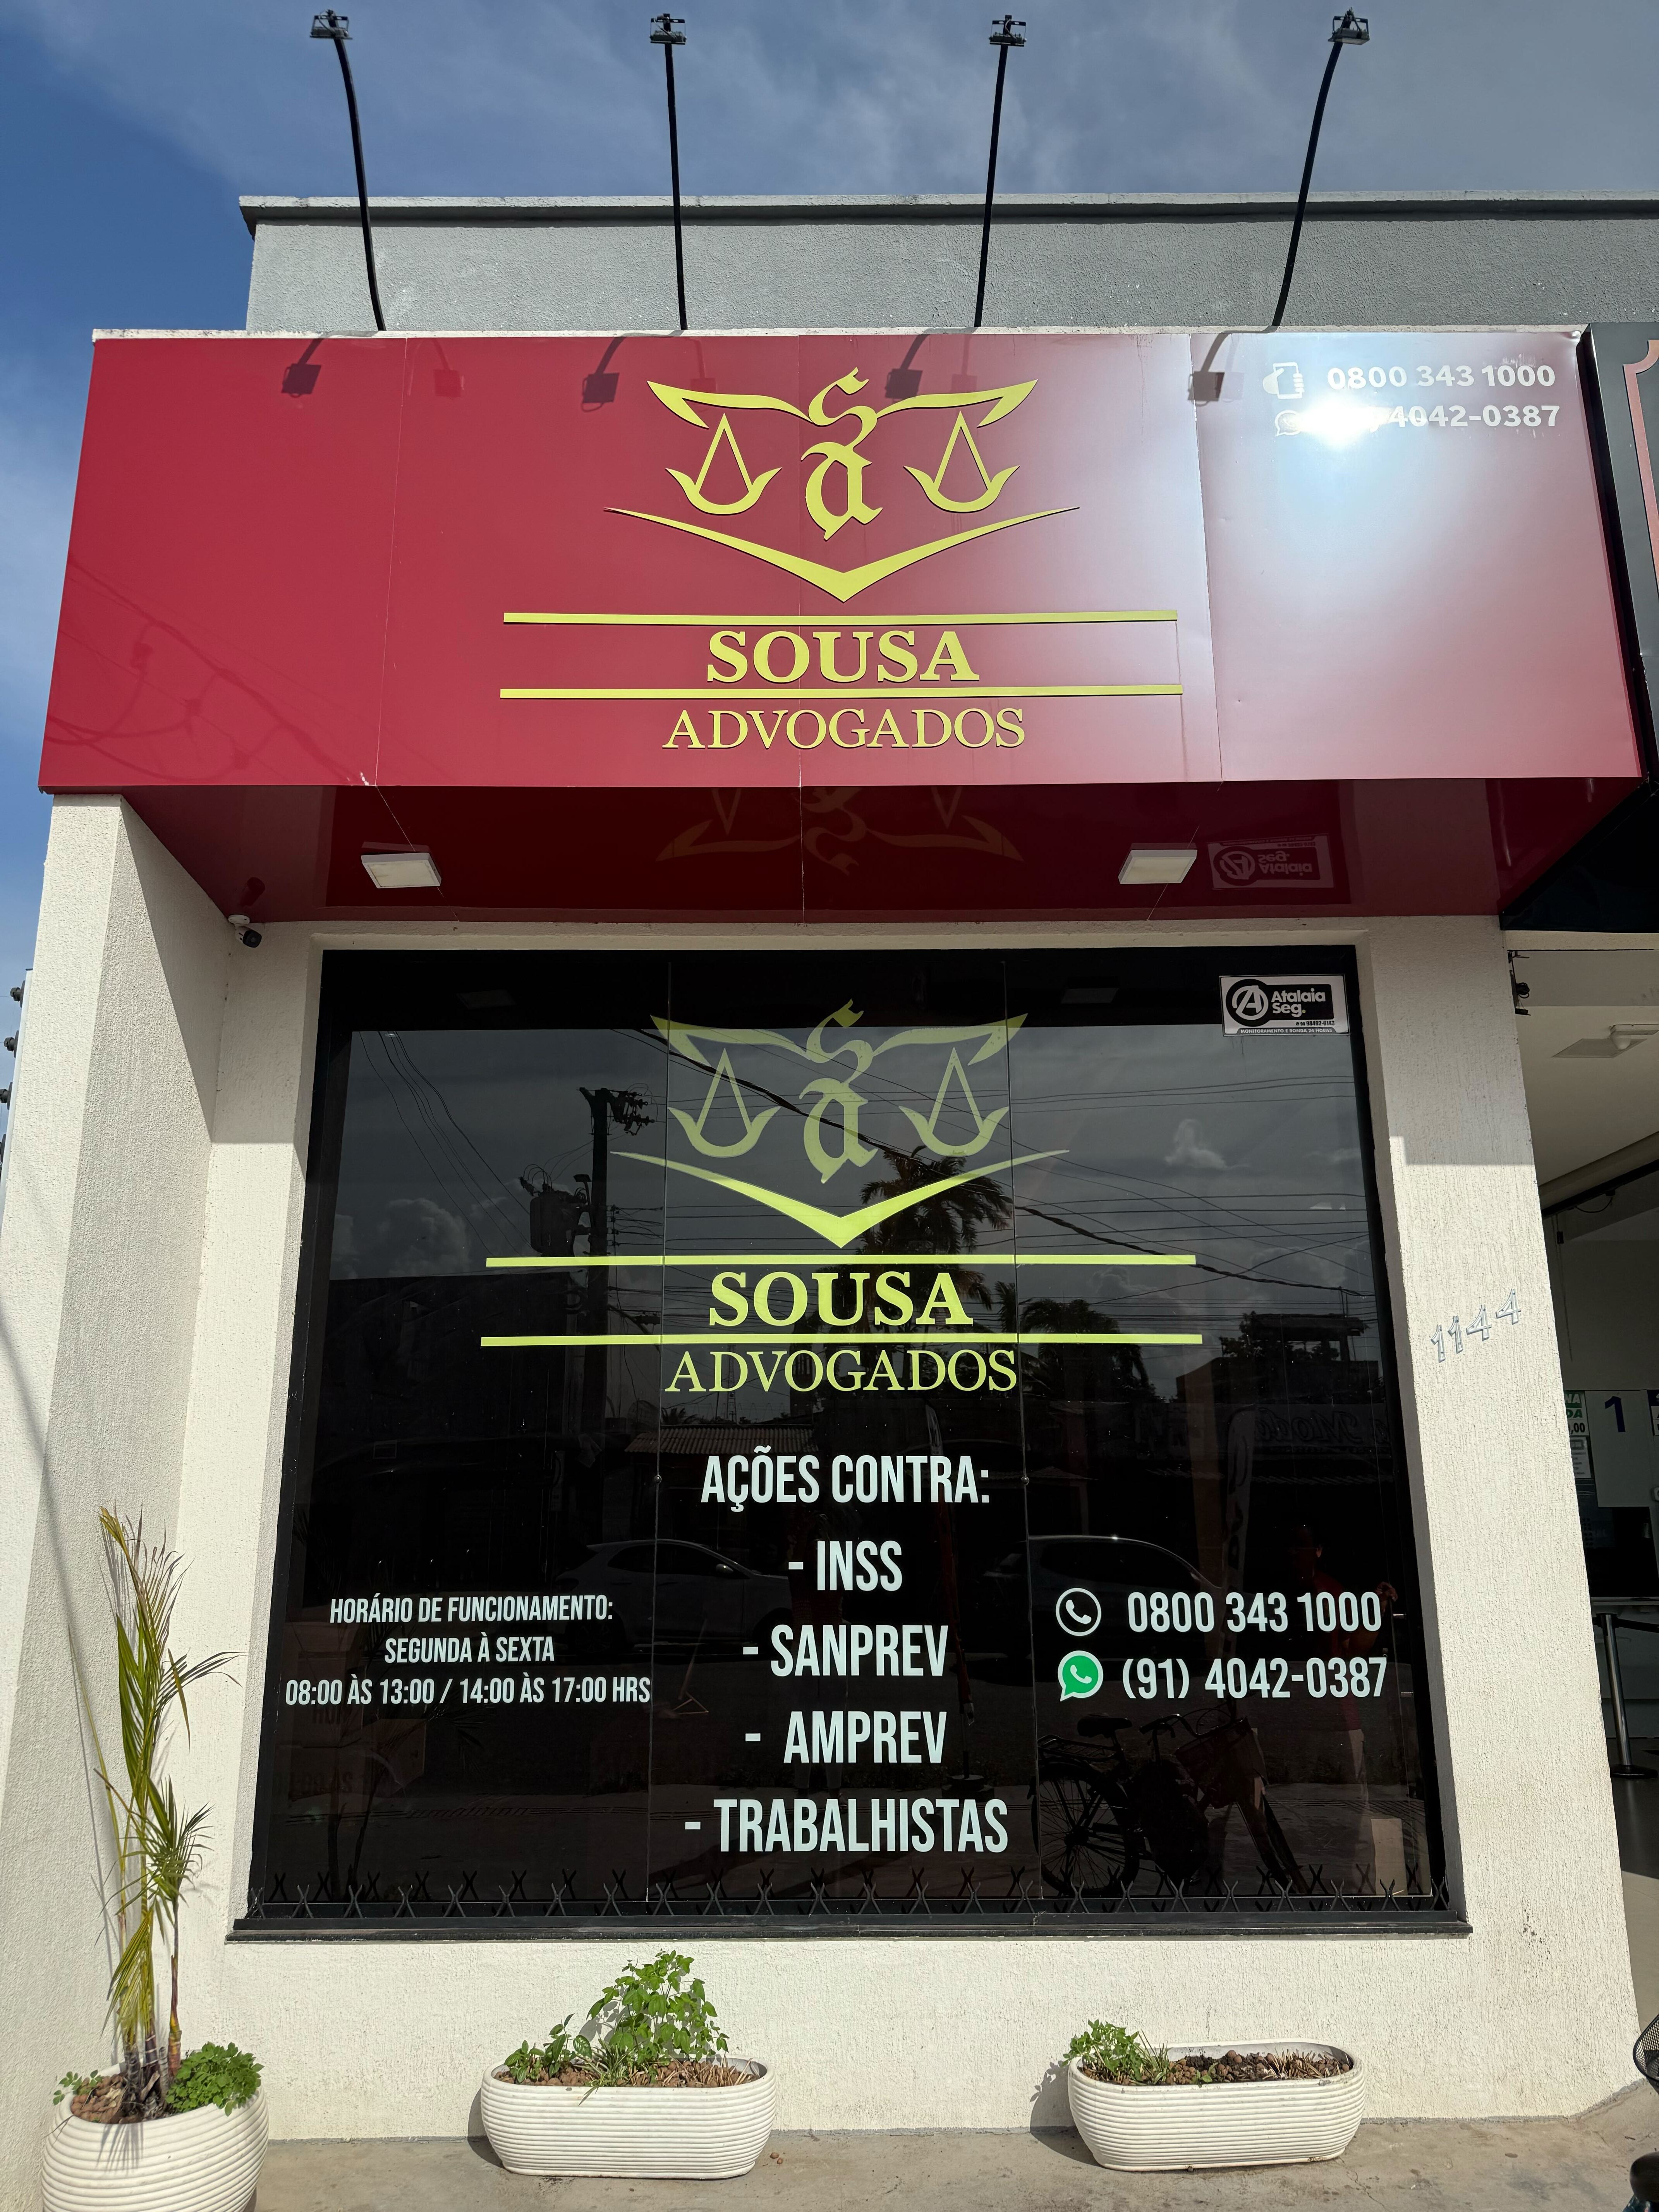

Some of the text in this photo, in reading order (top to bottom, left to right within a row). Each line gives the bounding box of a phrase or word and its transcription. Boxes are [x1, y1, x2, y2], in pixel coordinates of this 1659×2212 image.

[1328, 365, 1555, 390] 0800 343 1000
[1389, 405, 1560, 427] 4042-0387
[708, 631, 979, 682] SOUSA
[663, 708, 1024, 749] ADVOGADOS
[1271, 988, 1326, 1003] Atalaia
[1272, 1003, 1306, 1017] Seg.
[710, 1272, 973, 1326] SOUSA
[1430, 1288, 1522, 1363] 1144
[665, 1350, 1016, 1392] ADVOGADOS
[1605, 1396, 1626, 1432] 1
[701, 1445, 989, 1512] AÇÕES CONTRA:
[817, 1541, 902, 1591] INSS
[330, 1593, 612, 1623] HORÁRIO DE FUNCIONAMENTO:
[1128, 1592, 1381, 1632] 0800 343 1000
[385, 1632, 554, 1663] SEGUNDA À SEXTA
[771, 1625, 948, 1676] SANPREV
[286, 1673, 650, 1705] 08:00 ÀS 13:00 / 14:00 ÀS 17:00 HRS
[1123, 1657, 1386, 1698] (91) 4042-0387
[784, 1711, 946, 1763] AMPREV
[714, 1798, 1008, 1852] TRABALHISTAS
